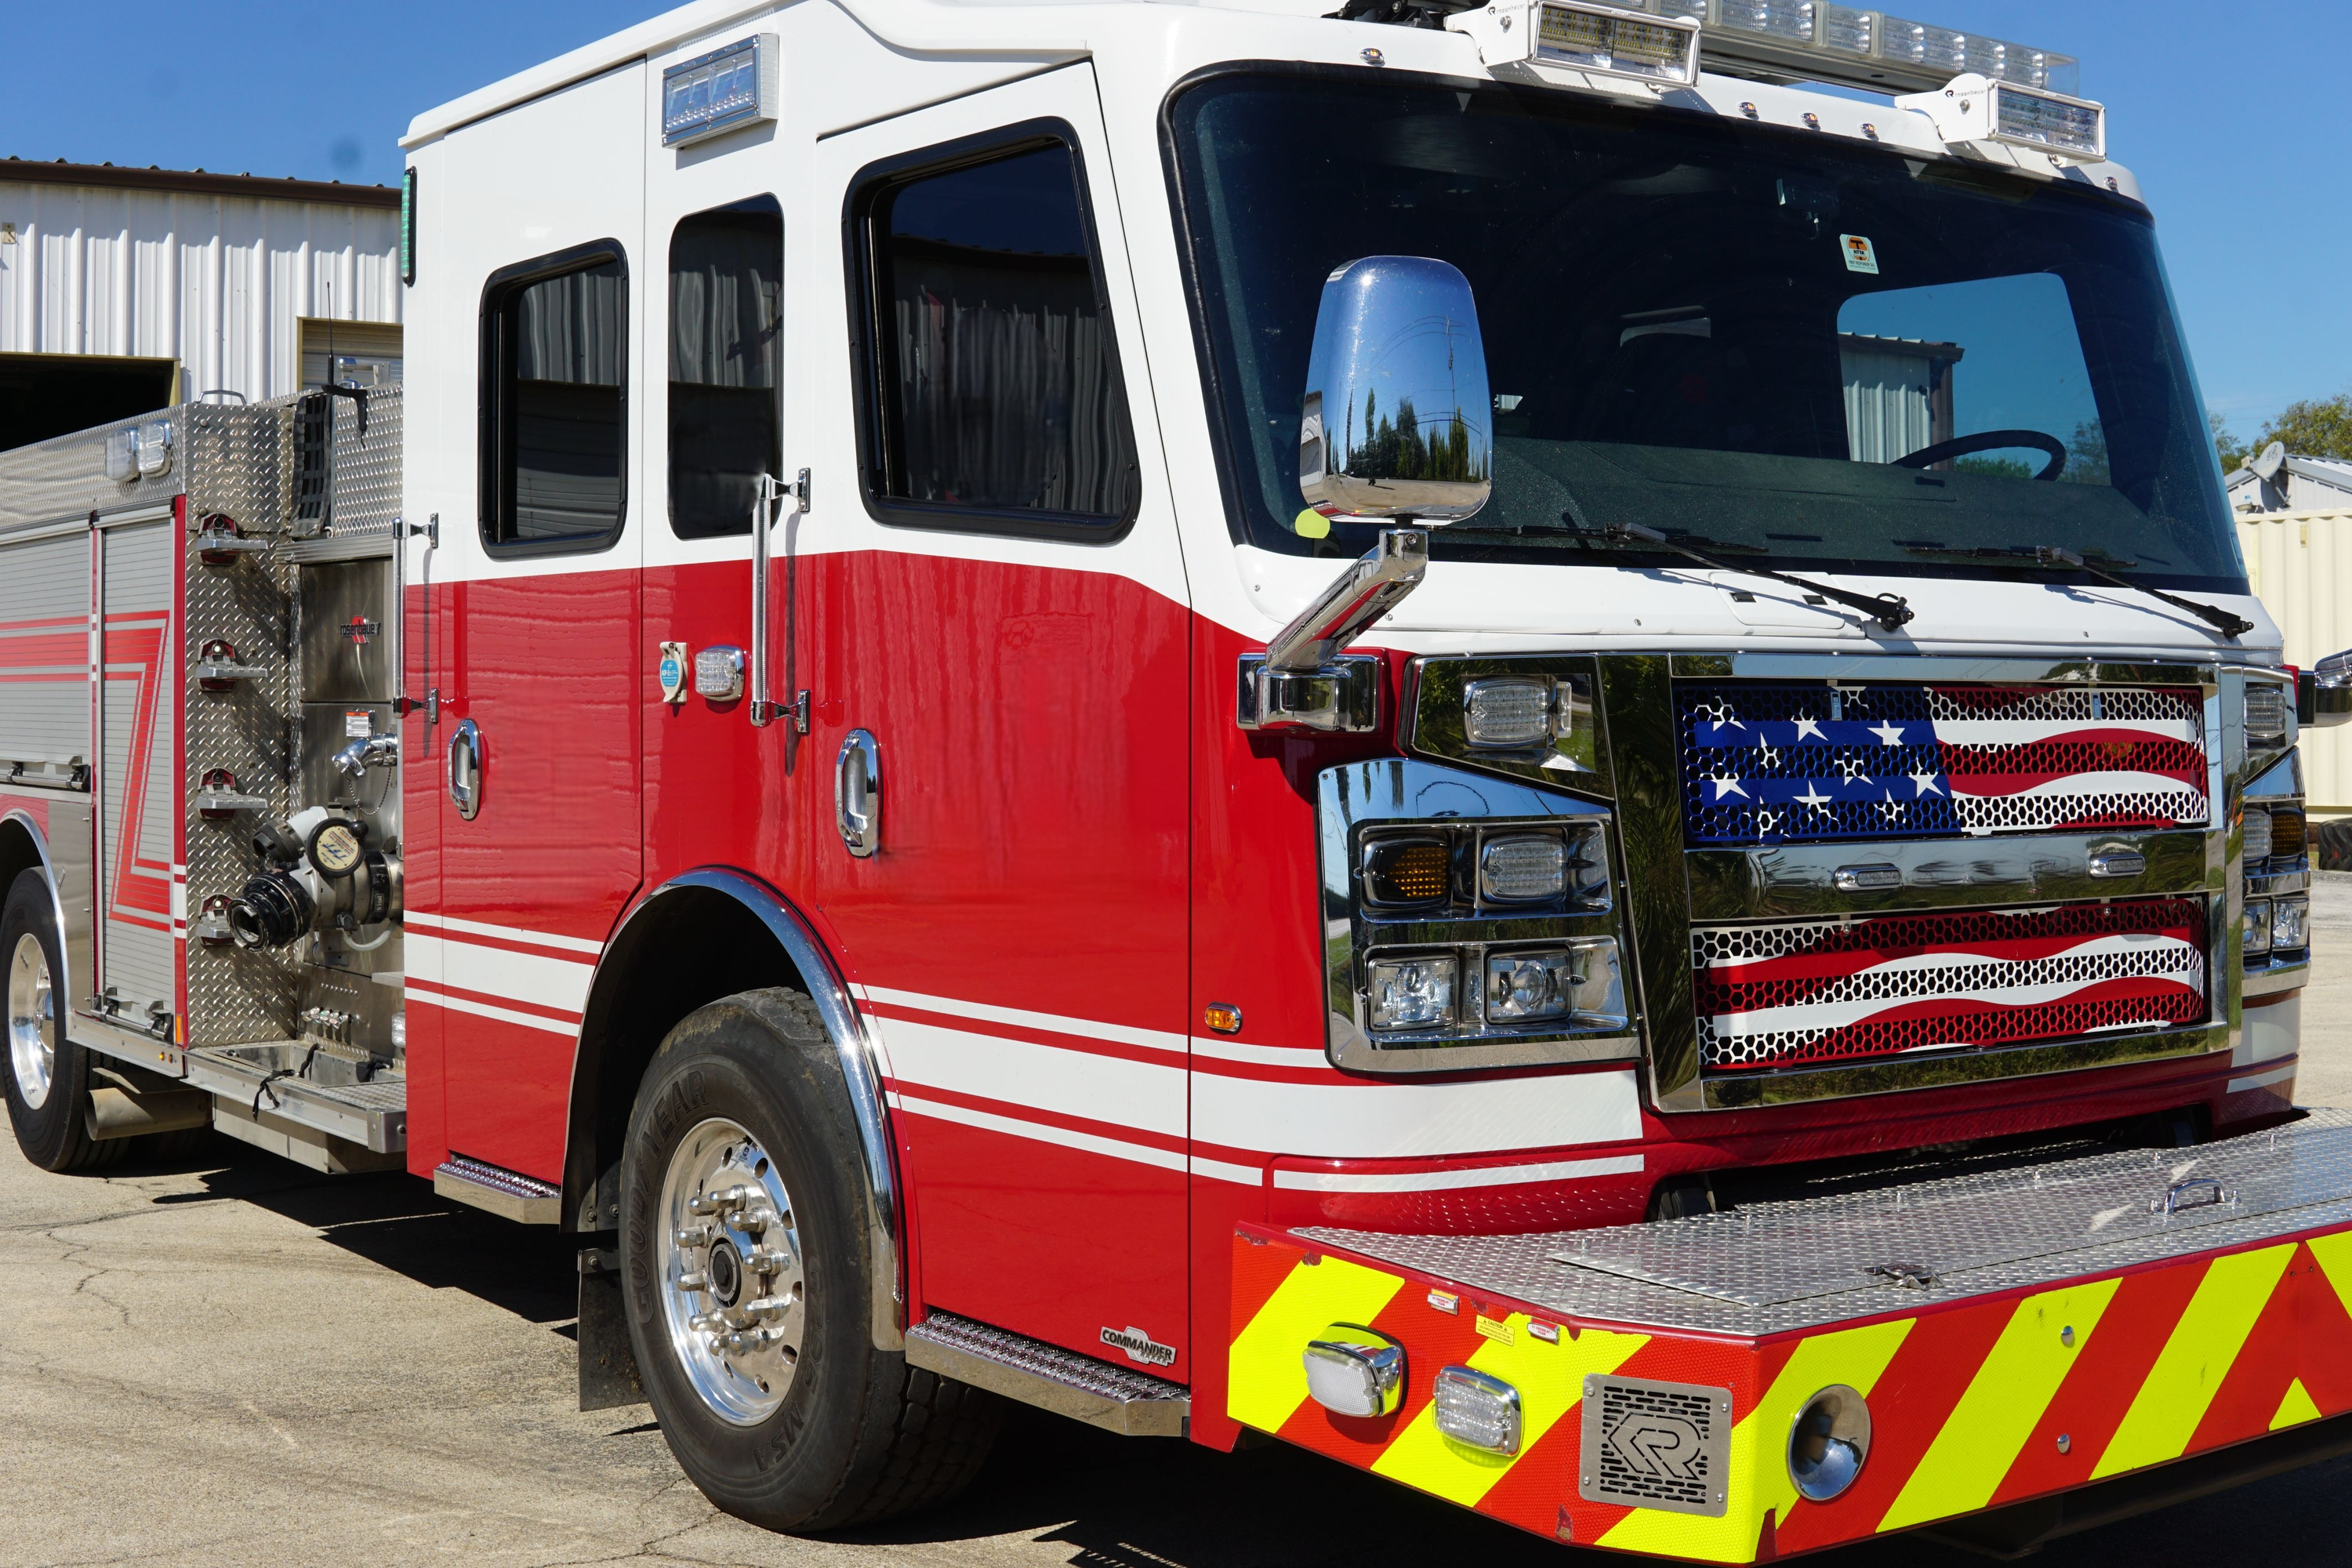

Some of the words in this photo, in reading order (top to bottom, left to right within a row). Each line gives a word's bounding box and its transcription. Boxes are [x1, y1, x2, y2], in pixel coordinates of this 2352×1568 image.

[340, 622, 381, 637] rosenbauer
[1487, 1319, 1503, 1329] CAUTION
[1102, 1329, 1173, 1360] COMMANDER
[753, 1401, 805, 1472] MSA
